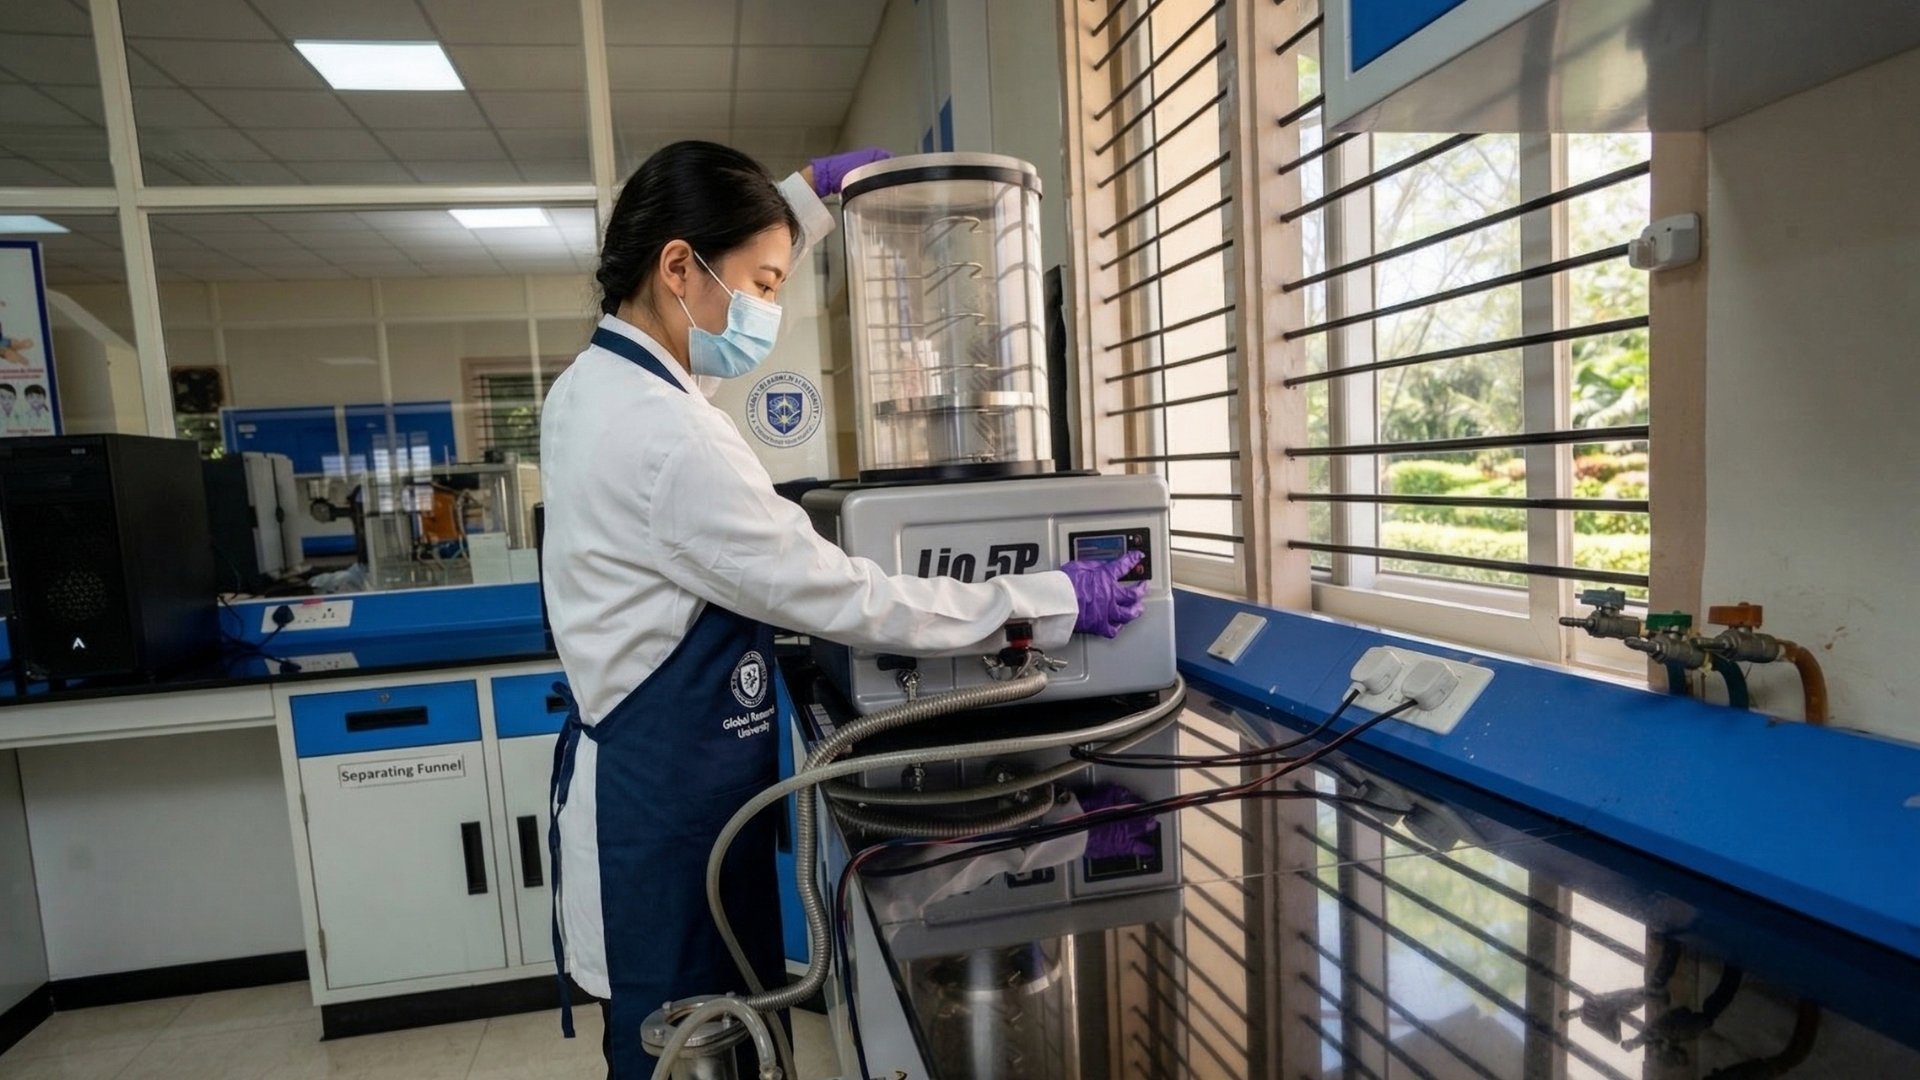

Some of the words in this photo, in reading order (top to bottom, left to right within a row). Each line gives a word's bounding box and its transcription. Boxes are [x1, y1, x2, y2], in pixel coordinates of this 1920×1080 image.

[984, 543, 1040, 582] 5P
[722, 713, 750, 730] Global
[737, 721, 770, 738] University
[341, 765, 415, 783] Separating
[417, 760, 462, 774] Funnel
